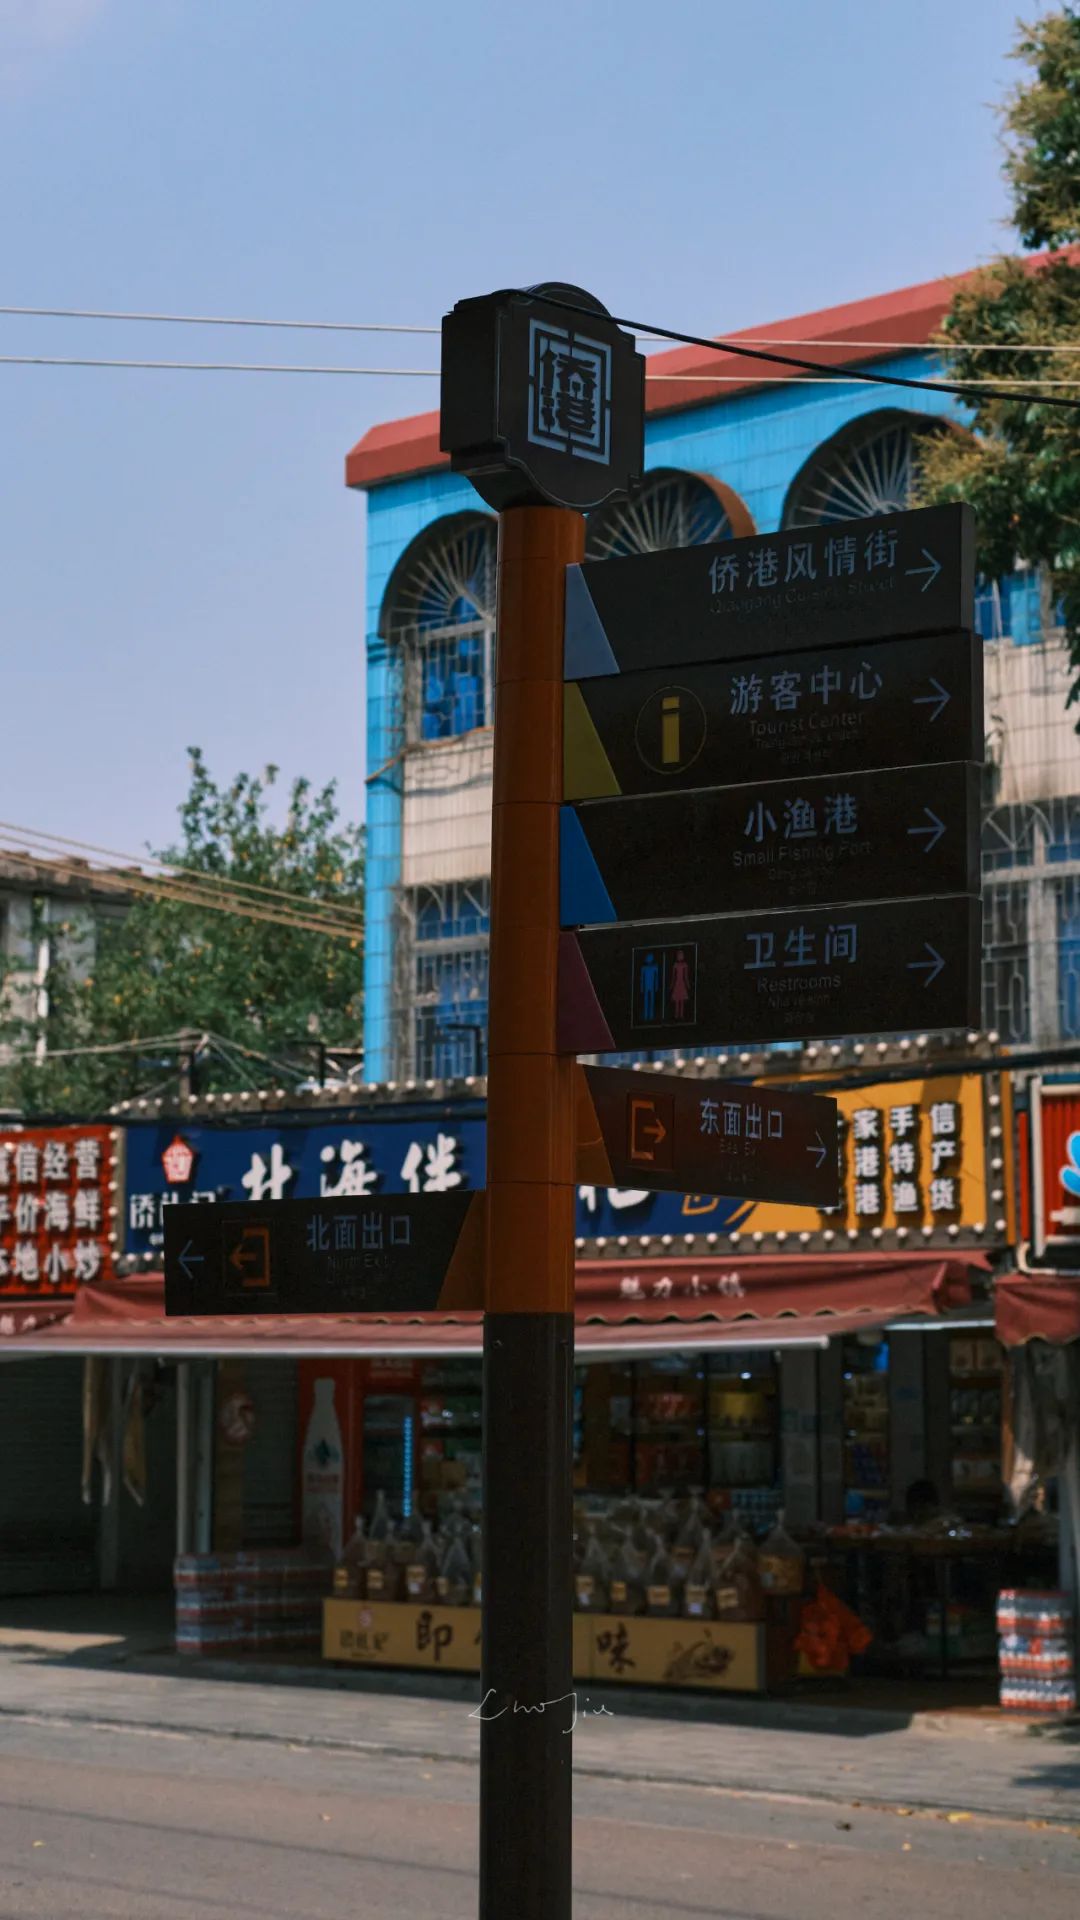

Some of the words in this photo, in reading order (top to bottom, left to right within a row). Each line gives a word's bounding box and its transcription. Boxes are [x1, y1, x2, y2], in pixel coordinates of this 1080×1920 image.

[708, 529, 899, 595] 侨港风情街
[729, 661, 883, 716] 游客中心
[749, 717, 804, 736] Tourist
[809, 710, 866, 730] Center
[744, 793, 857, 843] 小渔港
[732, 848, 775, 867] Small
[778, 842, 834, 862] Fishing
[838, 840, 873, 857] Port
[743, 923, 858, 970] 卫生间
[757, 973, 842, 993] Restrooms
[699, 1097, 785, 1140] 东面出口
[837, 1102, 955, 1140] 家手信
[838, 1140, 955, 1178] 港特产
[826, 1178, 957, 1215] 港渔货
[305, 1211, 411, 1253] 北面出口
